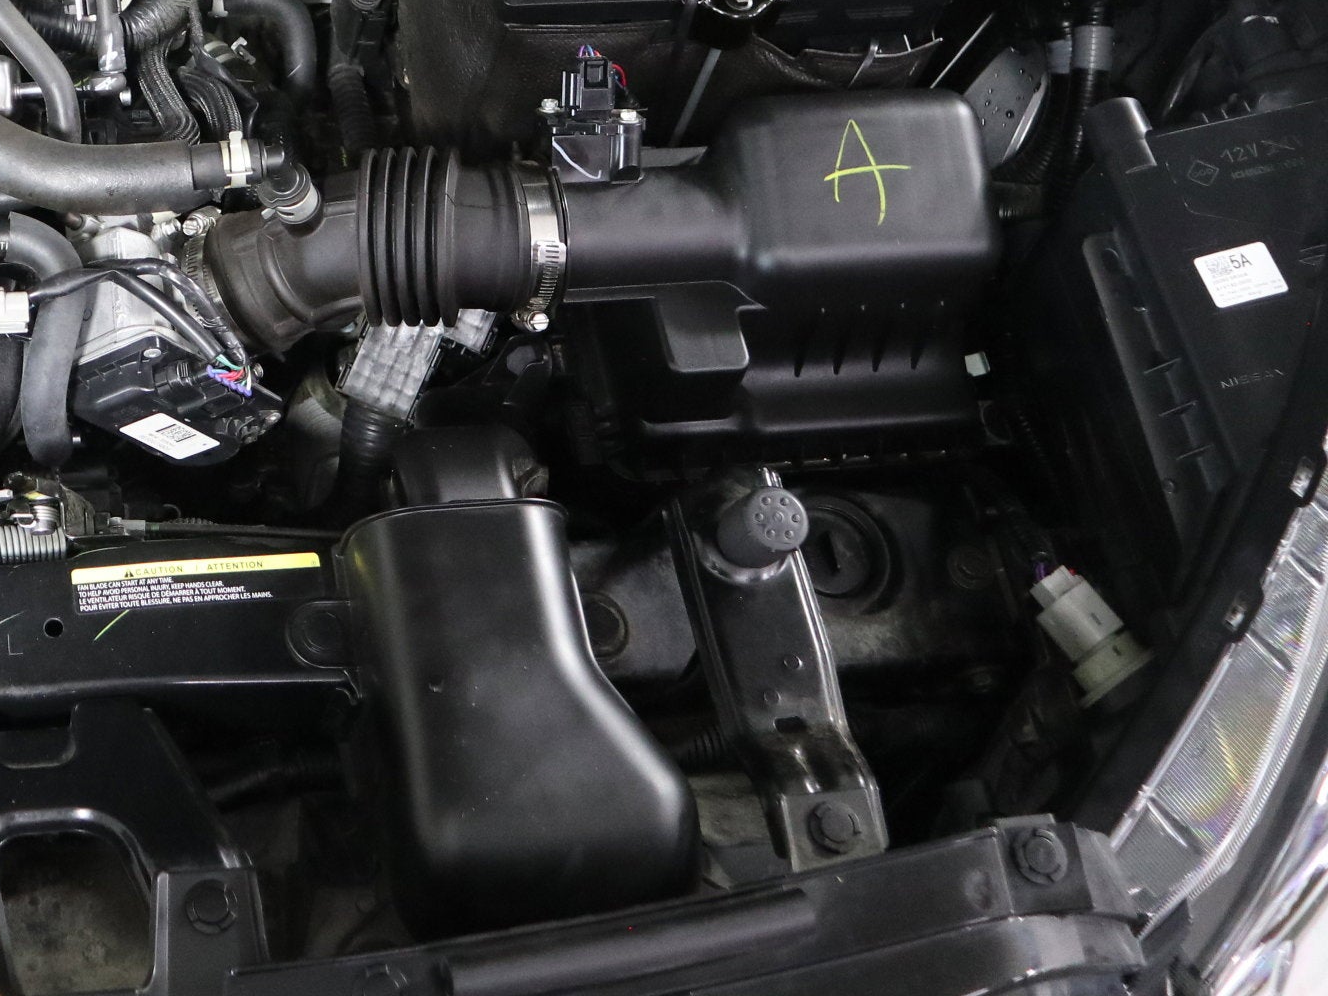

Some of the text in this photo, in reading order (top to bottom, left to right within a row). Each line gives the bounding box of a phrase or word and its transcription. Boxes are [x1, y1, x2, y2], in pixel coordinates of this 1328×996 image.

[824, 119, 912, 226] A
[1229, 252, 1253, 269] 5A
[135, 565, 184, 576] CAUTION
[207, 561, 264, 571] ATTENTION
[87, 589, 102, 597] HELP
[102, 587, 120, 595] AVOID
[120, 585, 149, 594] PERSONAL
[149, 584, 170, 592] INJURY,
[185, 581, 205, 589] HANDS
[121, 579, 138, 587] START
[79, 597, 87, 605] LE
[87, 594, 127, 604] VENTILATEUR
[128, 592, 150, 601] RISQUE
[160, 589, 194, 597] DÉMARRER
[217, 585, 246, 594] MOMENT.
[80, 603, 98, 612] POUR
[98, 601, 119, 610] ÉVITER
[119, 600, 140, 608] TOUTE
[182, 595, 193, 603] PAS
[194, 594, 203, 602] EN
[203, 592, 240, 602] APPROCHER
[240, 591, 251, 599] LES
[251, 590, 273, 598] MAINS.
